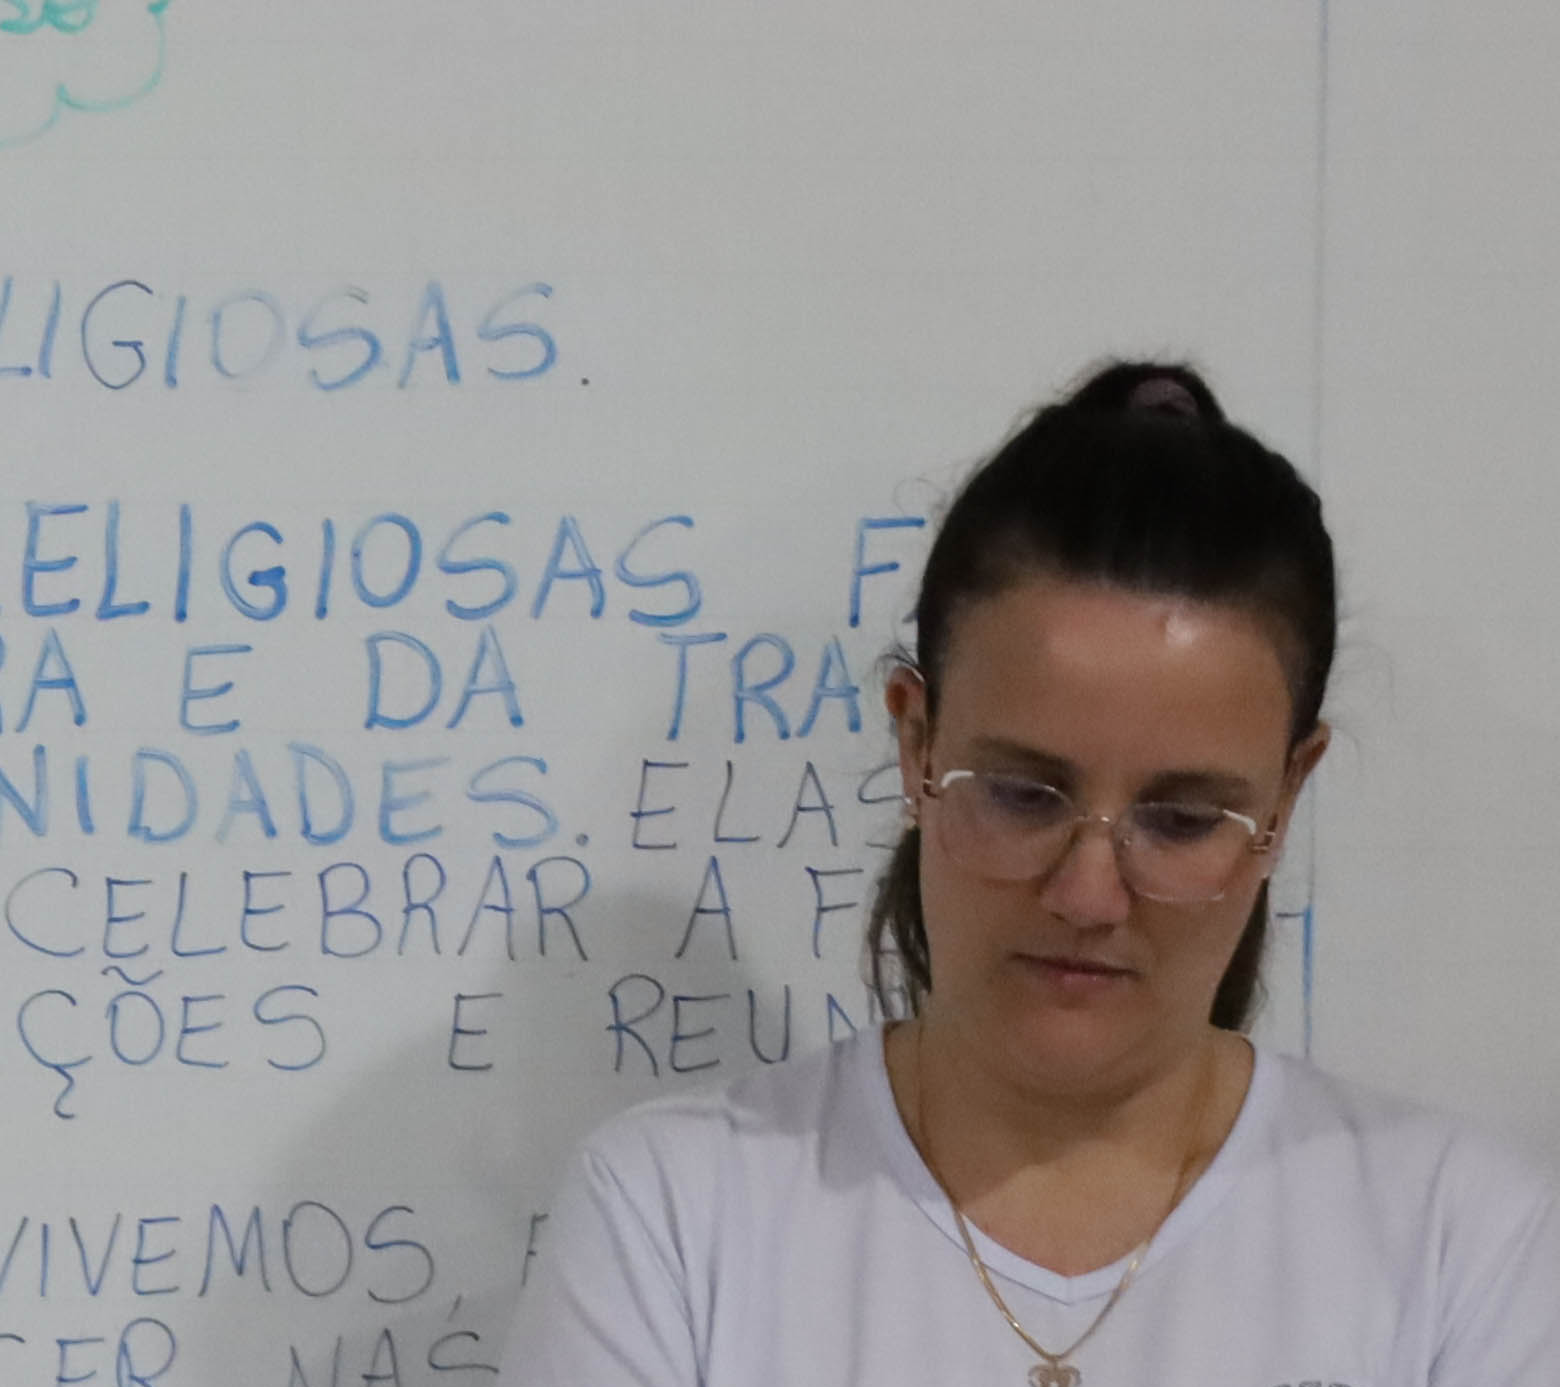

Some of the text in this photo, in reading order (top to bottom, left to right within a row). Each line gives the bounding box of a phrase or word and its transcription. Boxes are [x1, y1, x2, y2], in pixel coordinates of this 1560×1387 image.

[178, 643, 253, 732] E
[364, 627, 524, 732] DA
[658, 632, 862, 742] TRA
[629, 758, 903, 850] ELAS
[3, 853, 593, 960] CELEBRAR
[674, 854, 738, 961] A
[448, 992, 505, 1072] E
